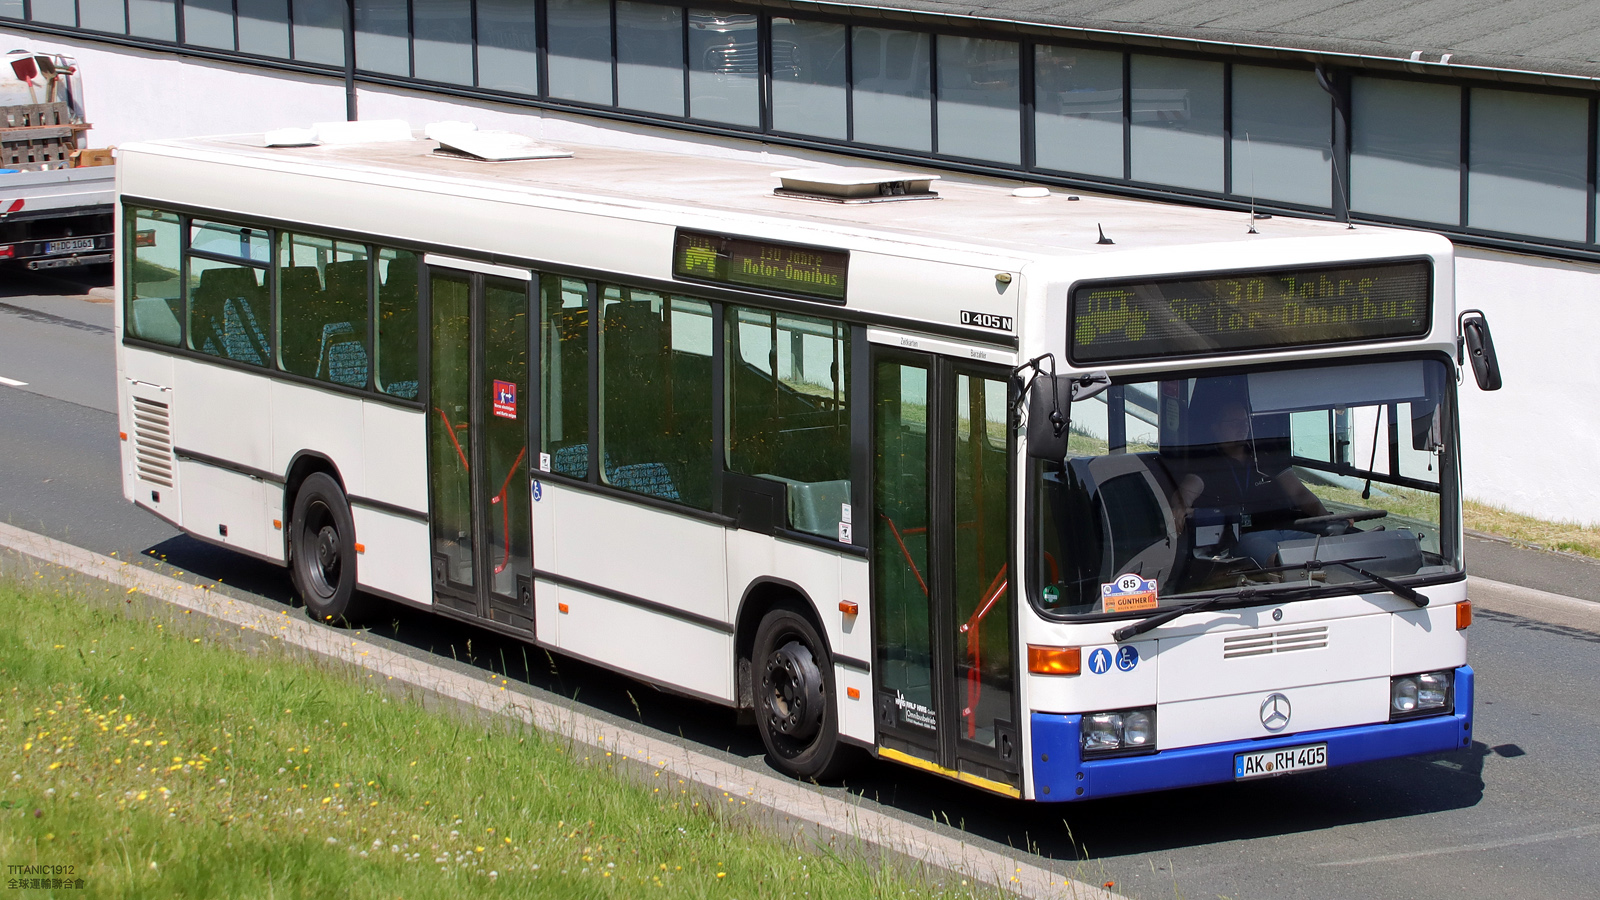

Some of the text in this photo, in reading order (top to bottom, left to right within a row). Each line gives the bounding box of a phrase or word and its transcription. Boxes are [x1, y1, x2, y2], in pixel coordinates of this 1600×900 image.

[743, 258, 838, 286] Motor-Omnibus
[973, 314, 1000, 328] 405
[1123, 580, 1136, 588] 85
[1117, 597, 1147, 606] GÜNTHER
[1246, 755, 1264, 774] AK
[1275, 751, 1294, 770] RH
[1298, 747, 1325, 766] 405
